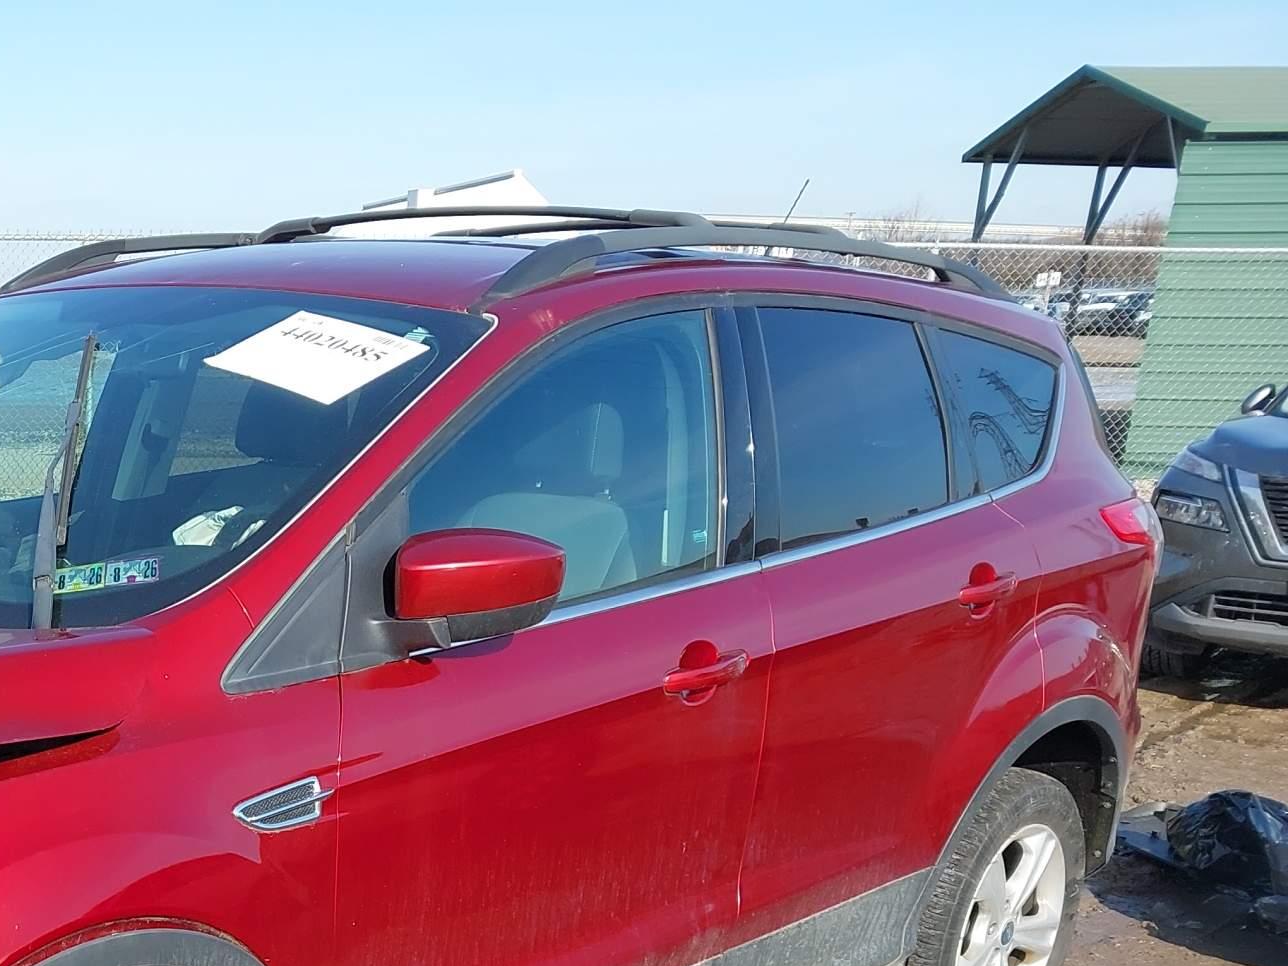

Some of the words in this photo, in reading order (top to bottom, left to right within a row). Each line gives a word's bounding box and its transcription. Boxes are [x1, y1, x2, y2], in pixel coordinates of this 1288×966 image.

[280, 327, 388, 362] 44020485
[89, 567, 103, 585] 26
[144, 559, 158, 579] 26
